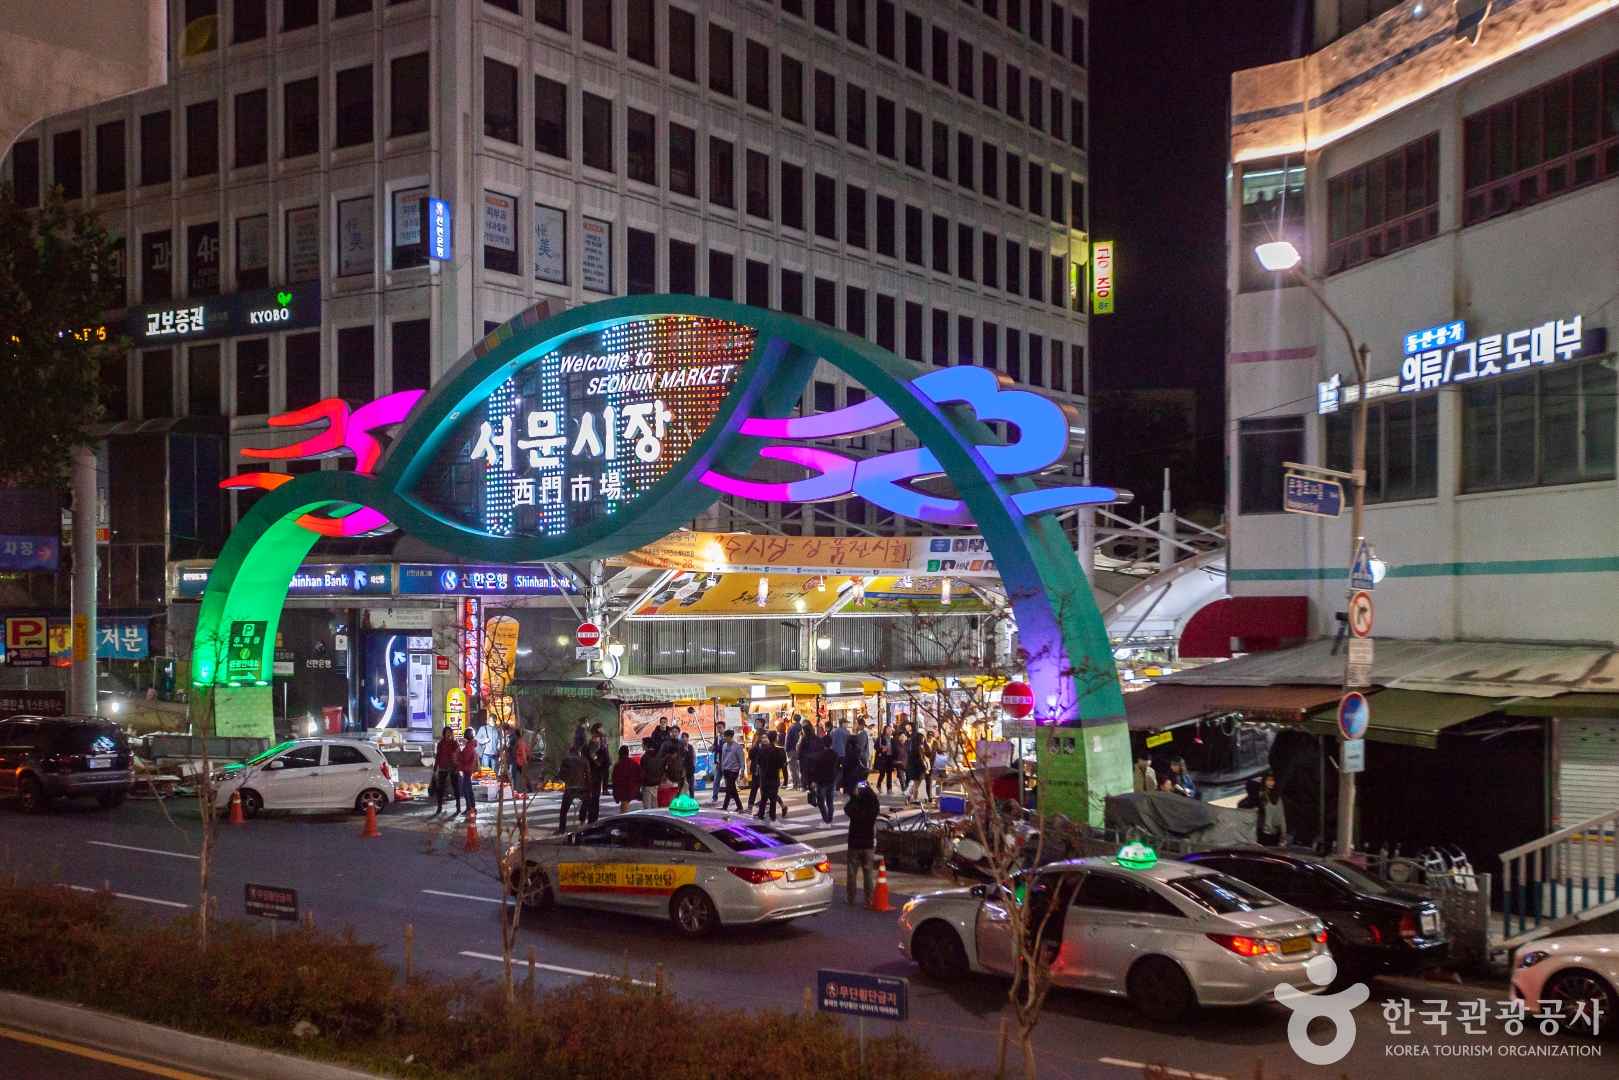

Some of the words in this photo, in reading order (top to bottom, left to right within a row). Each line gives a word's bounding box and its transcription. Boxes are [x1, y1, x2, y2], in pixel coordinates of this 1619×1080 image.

[145, 306, 205, 336] 교보증권
[249, 308, 290, 325] KYOBO
[1506, 315, 1584, 370] 도매부
[560, 351, 630, 373] Welcome
[635, 351, 654, 366] to
[586, 371, 656, 395] SEOMUN
[659, 364, 735, 388] MARKET
[470, 399, 674, 472] 서문시장
[512, 472, 621, 507] 西門市場
[324, 574, 349, 587] Bank
[462, 572, 508, 589] 신한은행
[516, 576, 549, 588] Shinhan
[12, 620, 42, 645] P
